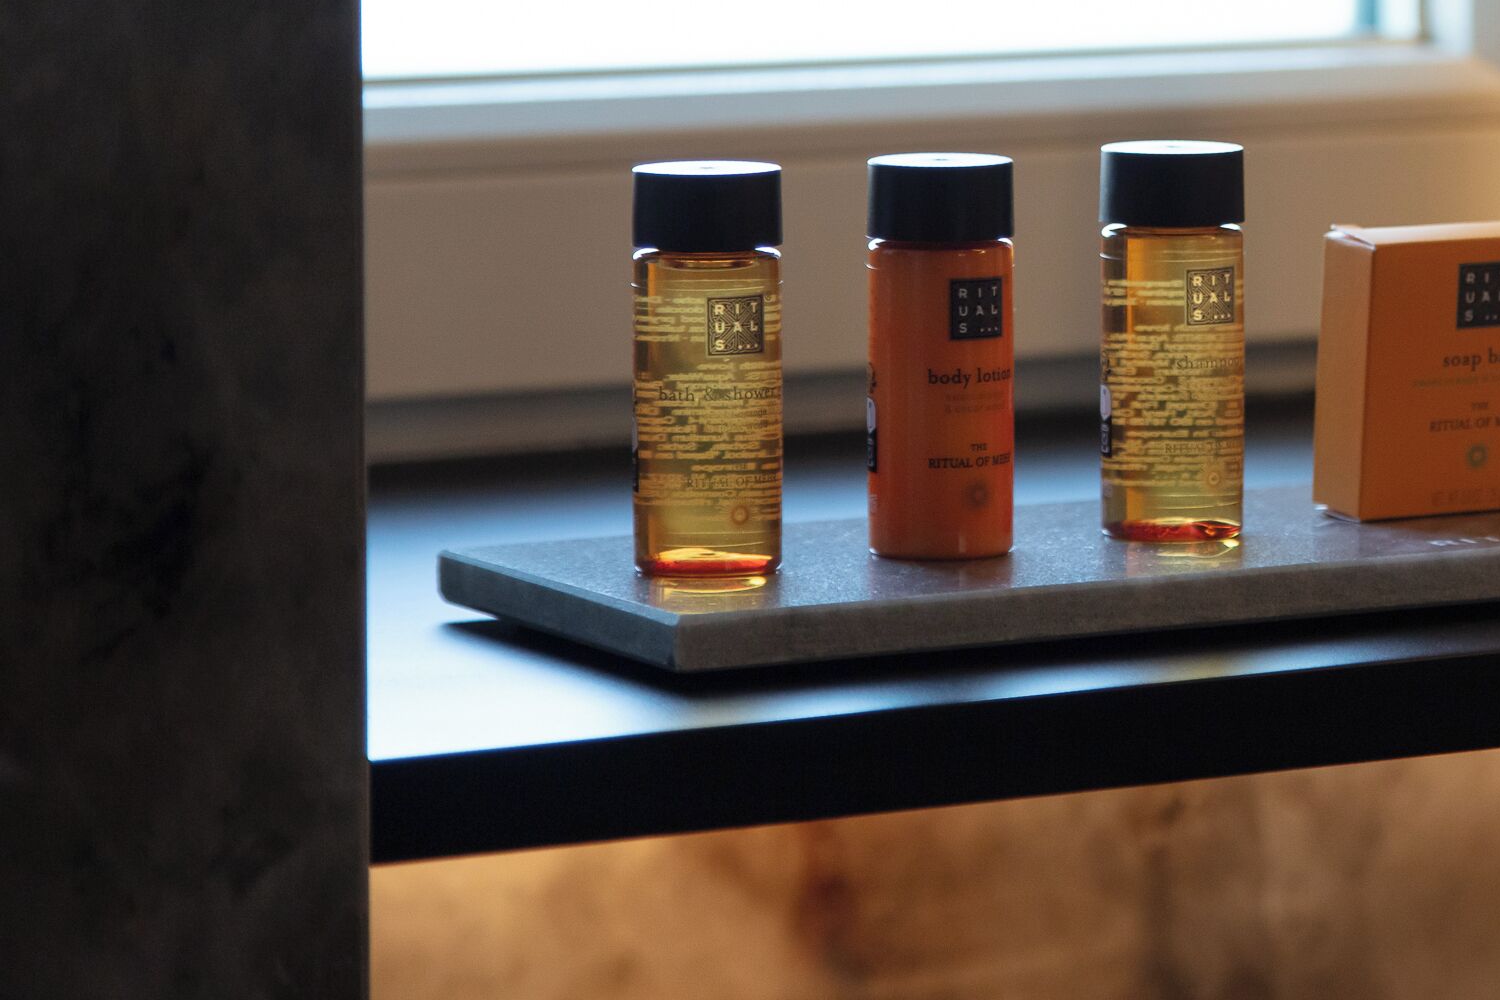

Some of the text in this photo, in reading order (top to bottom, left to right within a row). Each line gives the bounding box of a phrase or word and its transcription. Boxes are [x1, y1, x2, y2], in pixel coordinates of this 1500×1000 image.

[1442, 353, 1482, 372] soap
[927, 368, 971, 389] body
[658, 386, 695, 401] bath
[725, 385, 776, 400] shower
[1429, 417, 1473, 433] RITUAL
[1475, 416, 1491, 430] OF
[970, 443, 988, 452] THE
[927, 457, 974, 470] RITUAL
[975, 456, 990, 467] OF
